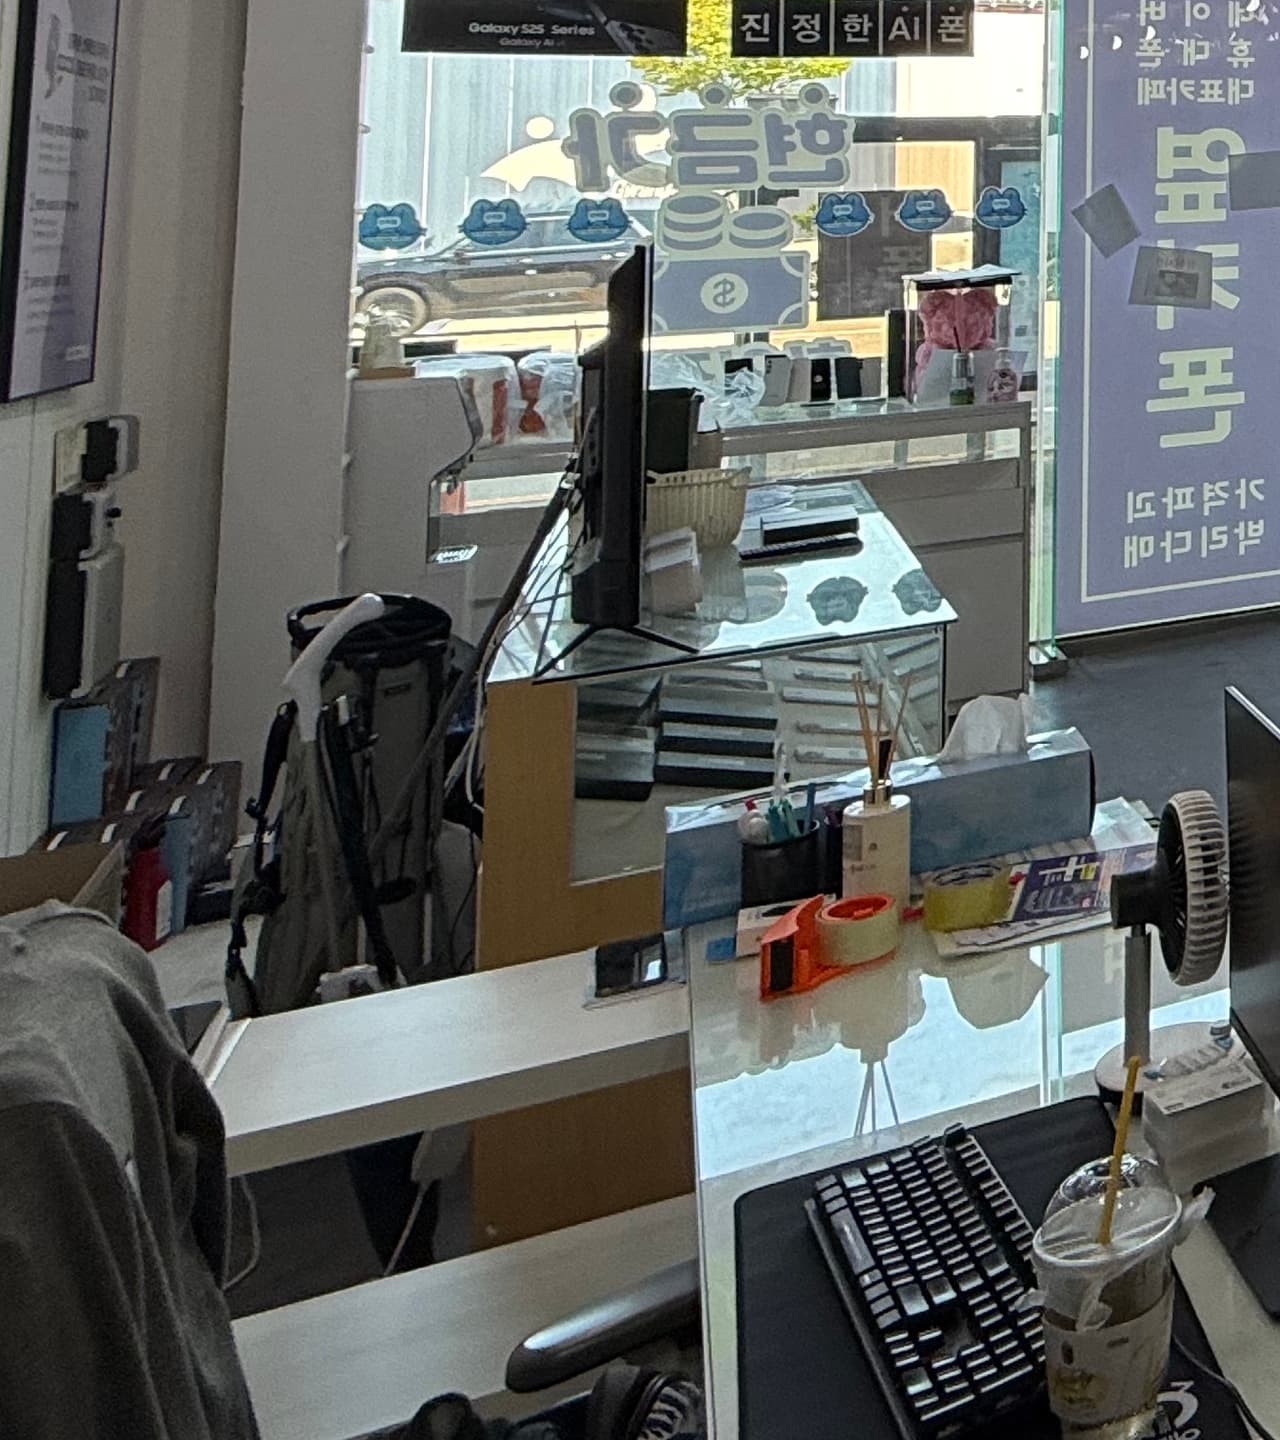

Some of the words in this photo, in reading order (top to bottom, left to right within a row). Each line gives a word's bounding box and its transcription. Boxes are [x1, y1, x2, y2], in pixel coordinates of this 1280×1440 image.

[468, 22, 519, 38] Galaxy
[521, 23, 544, 35] S25
[551, 24, 595, 36] Series
